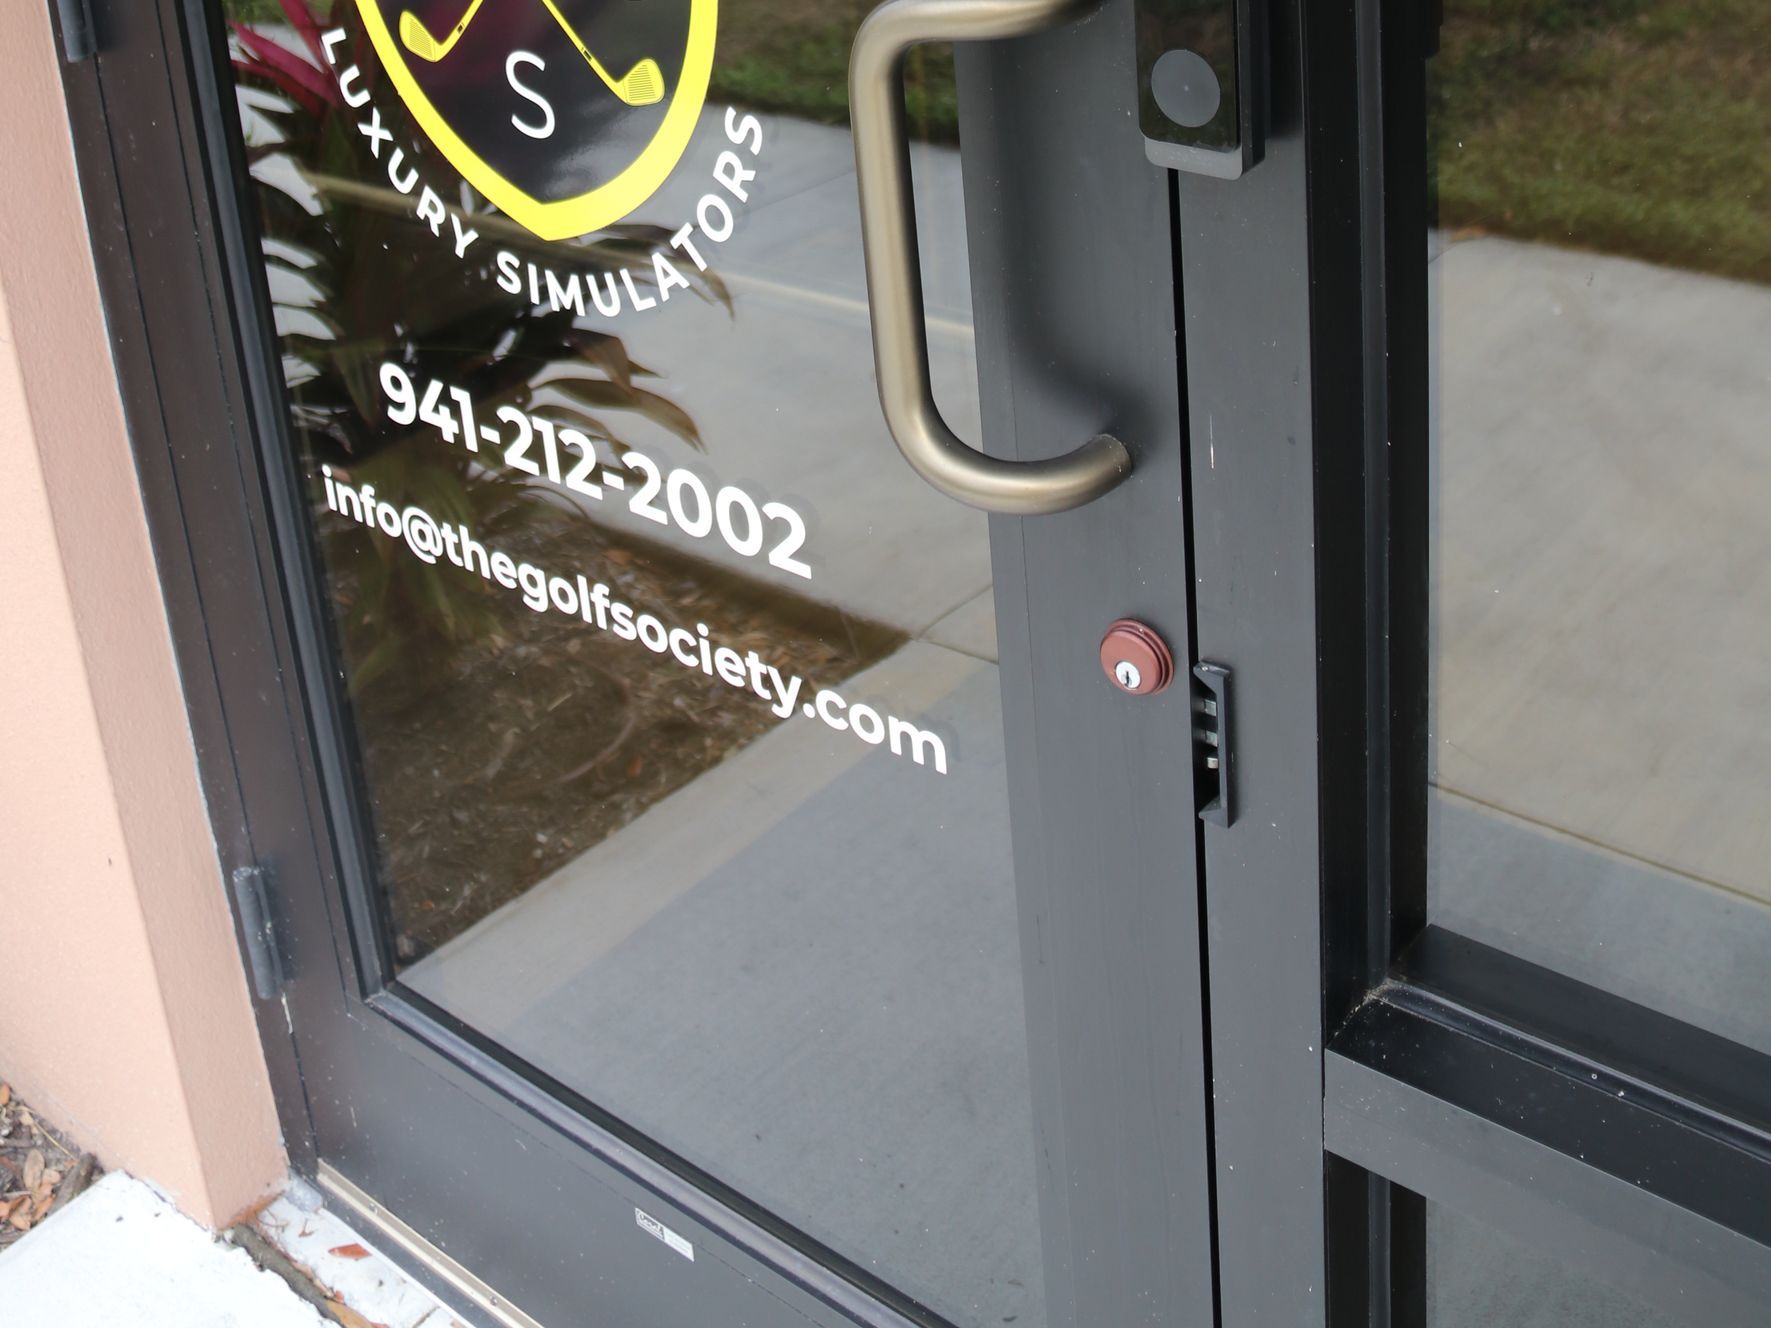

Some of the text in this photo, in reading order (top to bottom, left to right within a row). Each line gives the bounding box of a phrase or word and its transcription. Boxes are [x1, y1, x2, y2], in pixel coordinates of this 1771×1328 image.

[321, 27, 763, 317] LUXURY SIMULATORS
[505, 50, 556, 139] S
[379, 362, 812, 580] 941-212-2002
[322, 466, 948, 775] info@thegolfsociety.com
